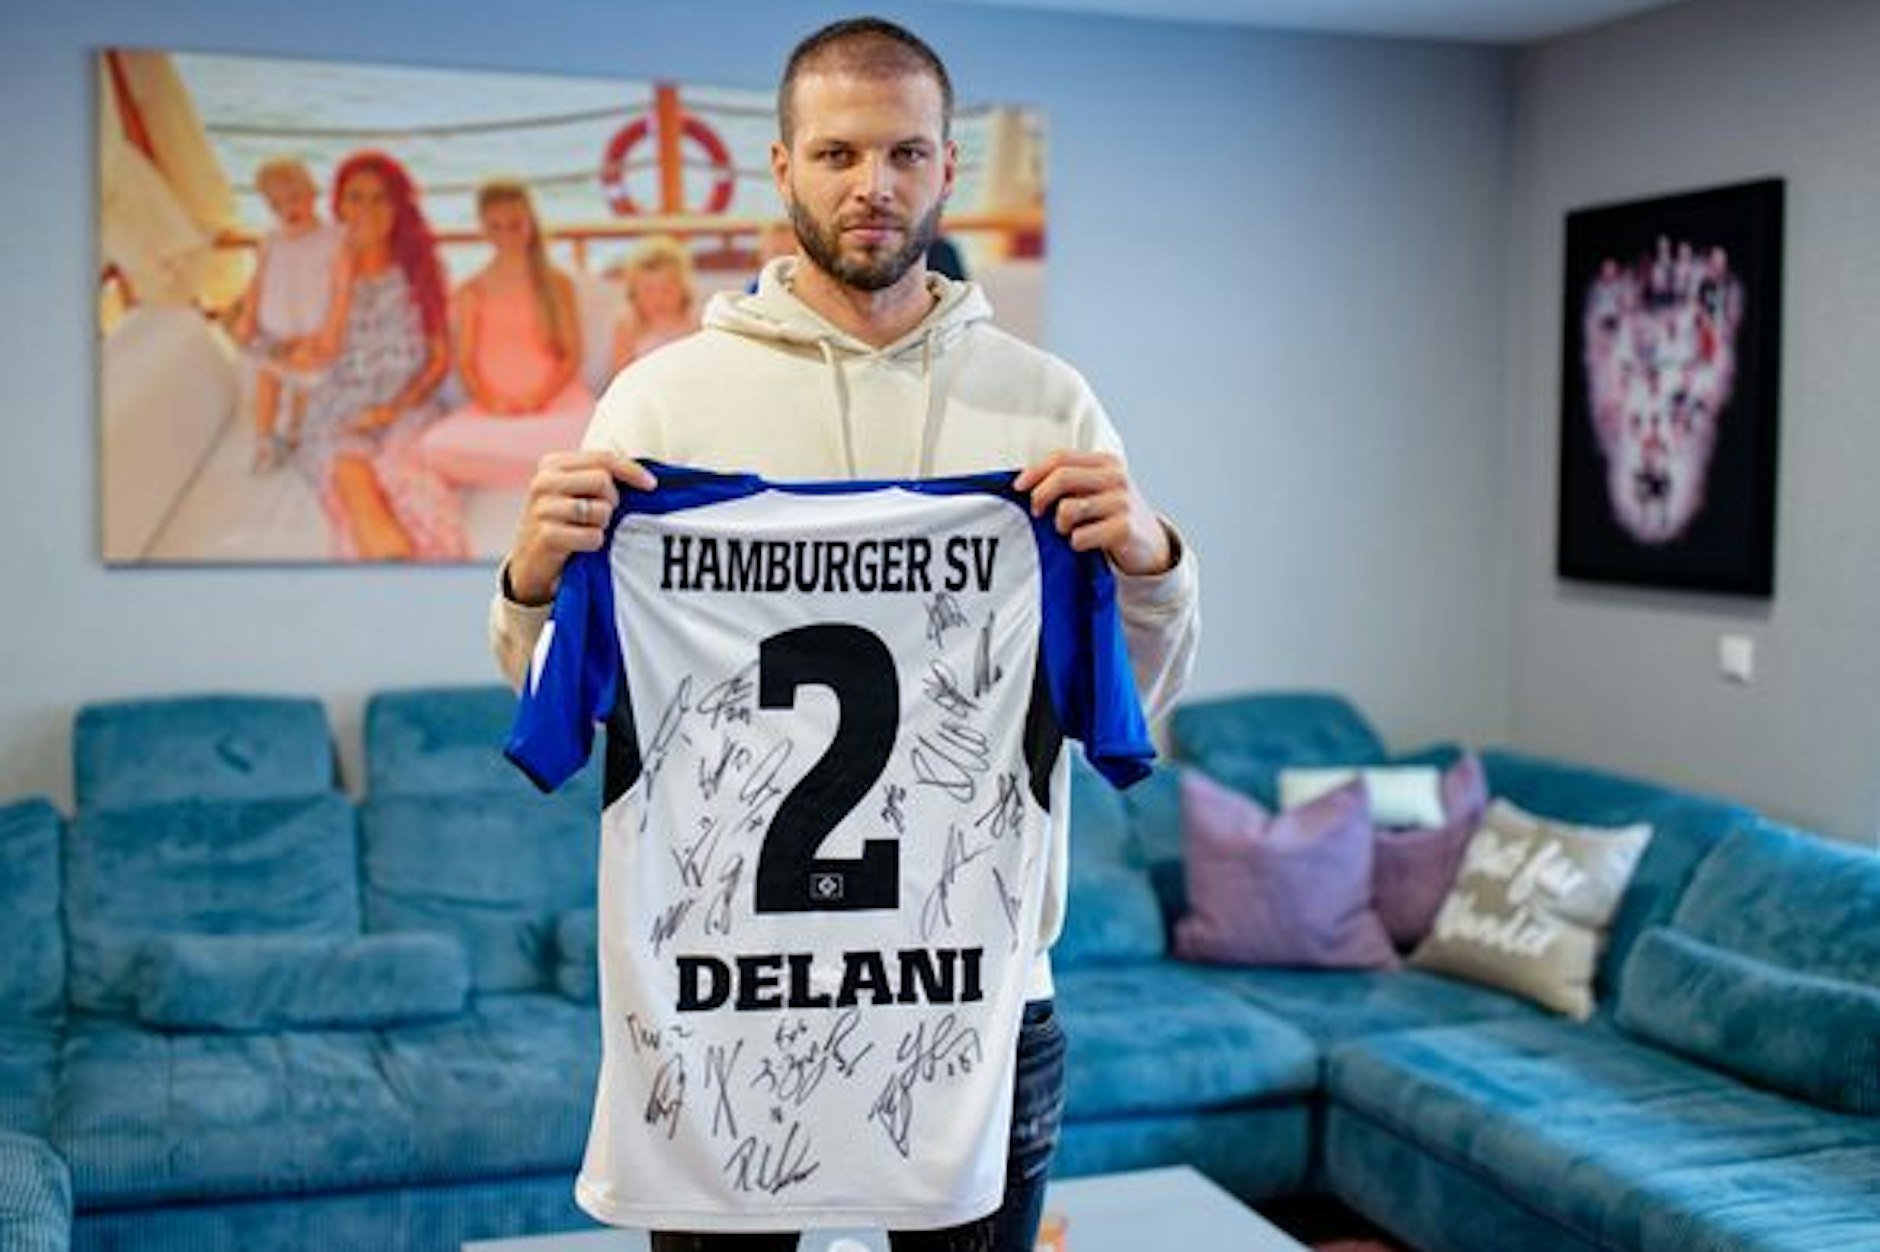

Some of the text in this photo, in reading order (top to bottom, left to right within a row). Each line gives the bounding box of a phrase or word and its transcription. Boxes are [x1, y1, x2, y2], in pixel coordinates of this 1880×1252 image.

[660, 534, 999, 592] HAMBURGER SV
[755, 622, 900, 914] 2
[676, 947, 984, 1012] DELANI
